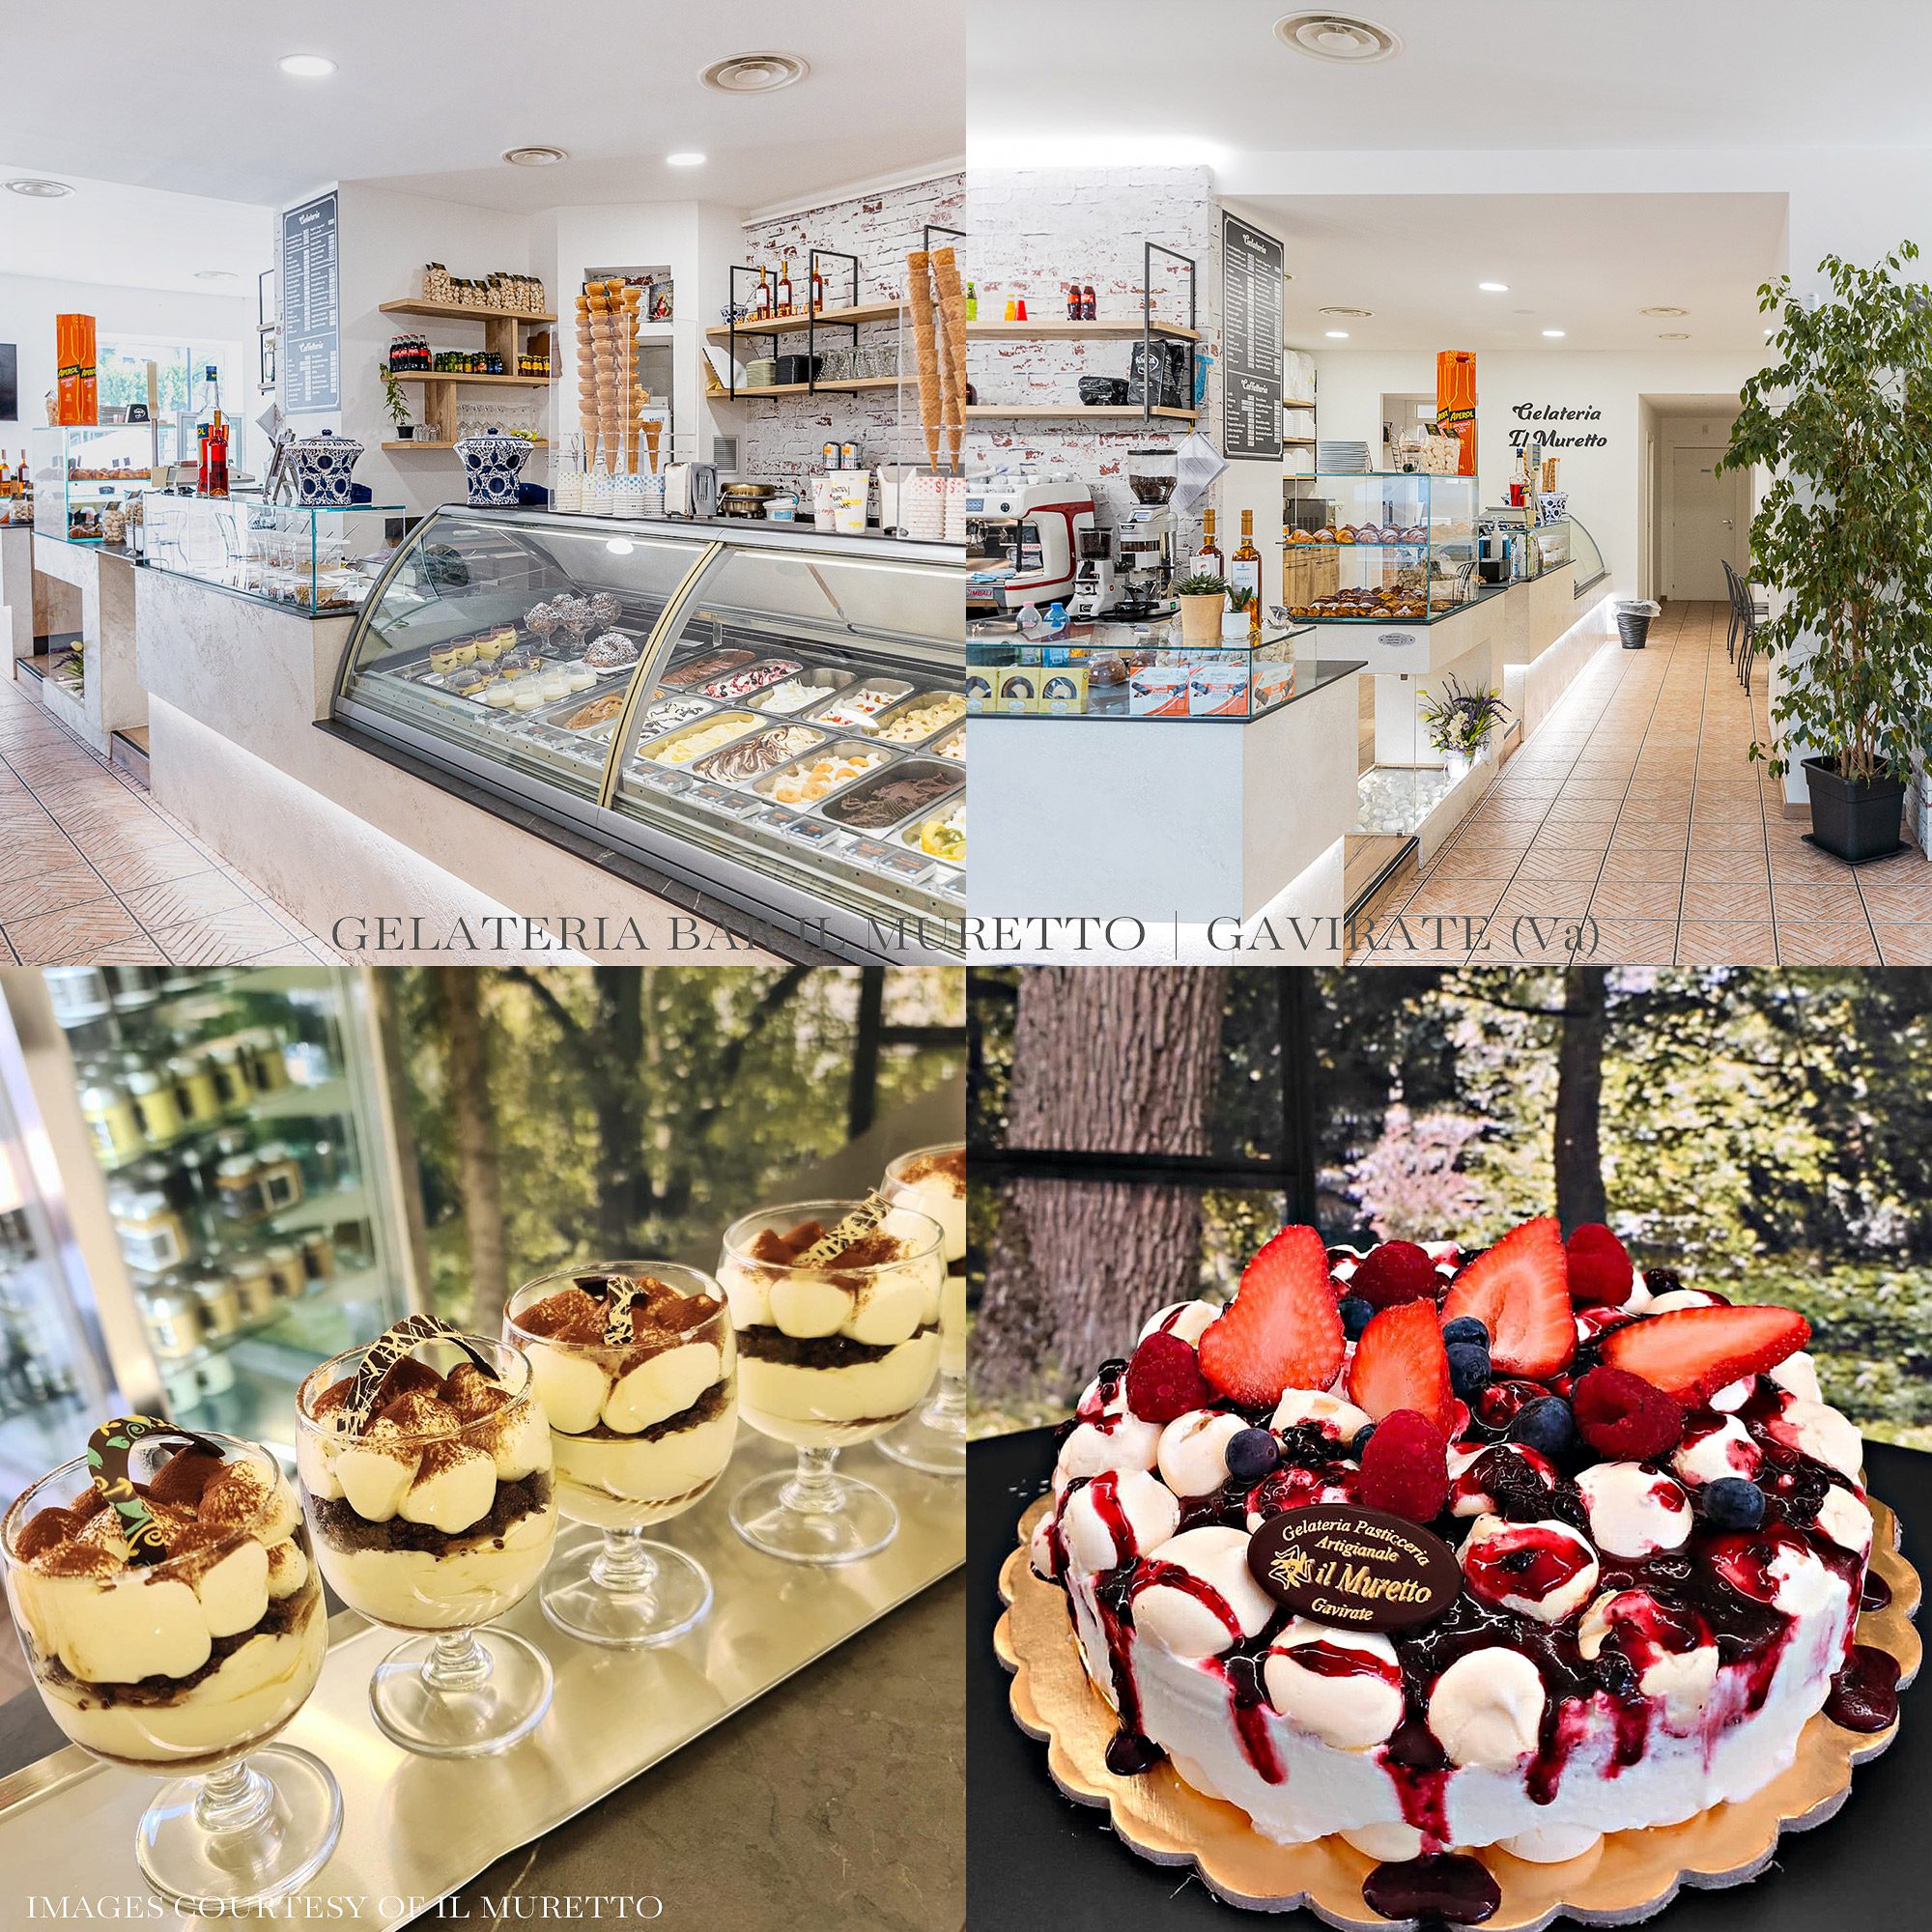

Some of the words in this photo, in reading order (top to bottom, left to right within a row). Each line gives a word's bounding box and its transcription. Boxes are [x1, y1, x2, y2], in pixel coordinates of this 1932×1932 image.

[1450, 411, 1474, 422] APEROL
[1512, 402, 1603, 421] Gelateria
[1509, 429, 1530, 448] Il
[1532, 429, 1608, 448] Muretto
[1282, 1519, 1350, 1542] Gelateria
[1352, 1520, 1432, 1567] Pasticceria
[1314, 1534, 1400, 1563] Artigianale
[1314, 1561, 1338, 1587] il
[1335, 1562, 1433, 1604] Muretto
[1311, 1597, 1374, 1621] Gavirate
